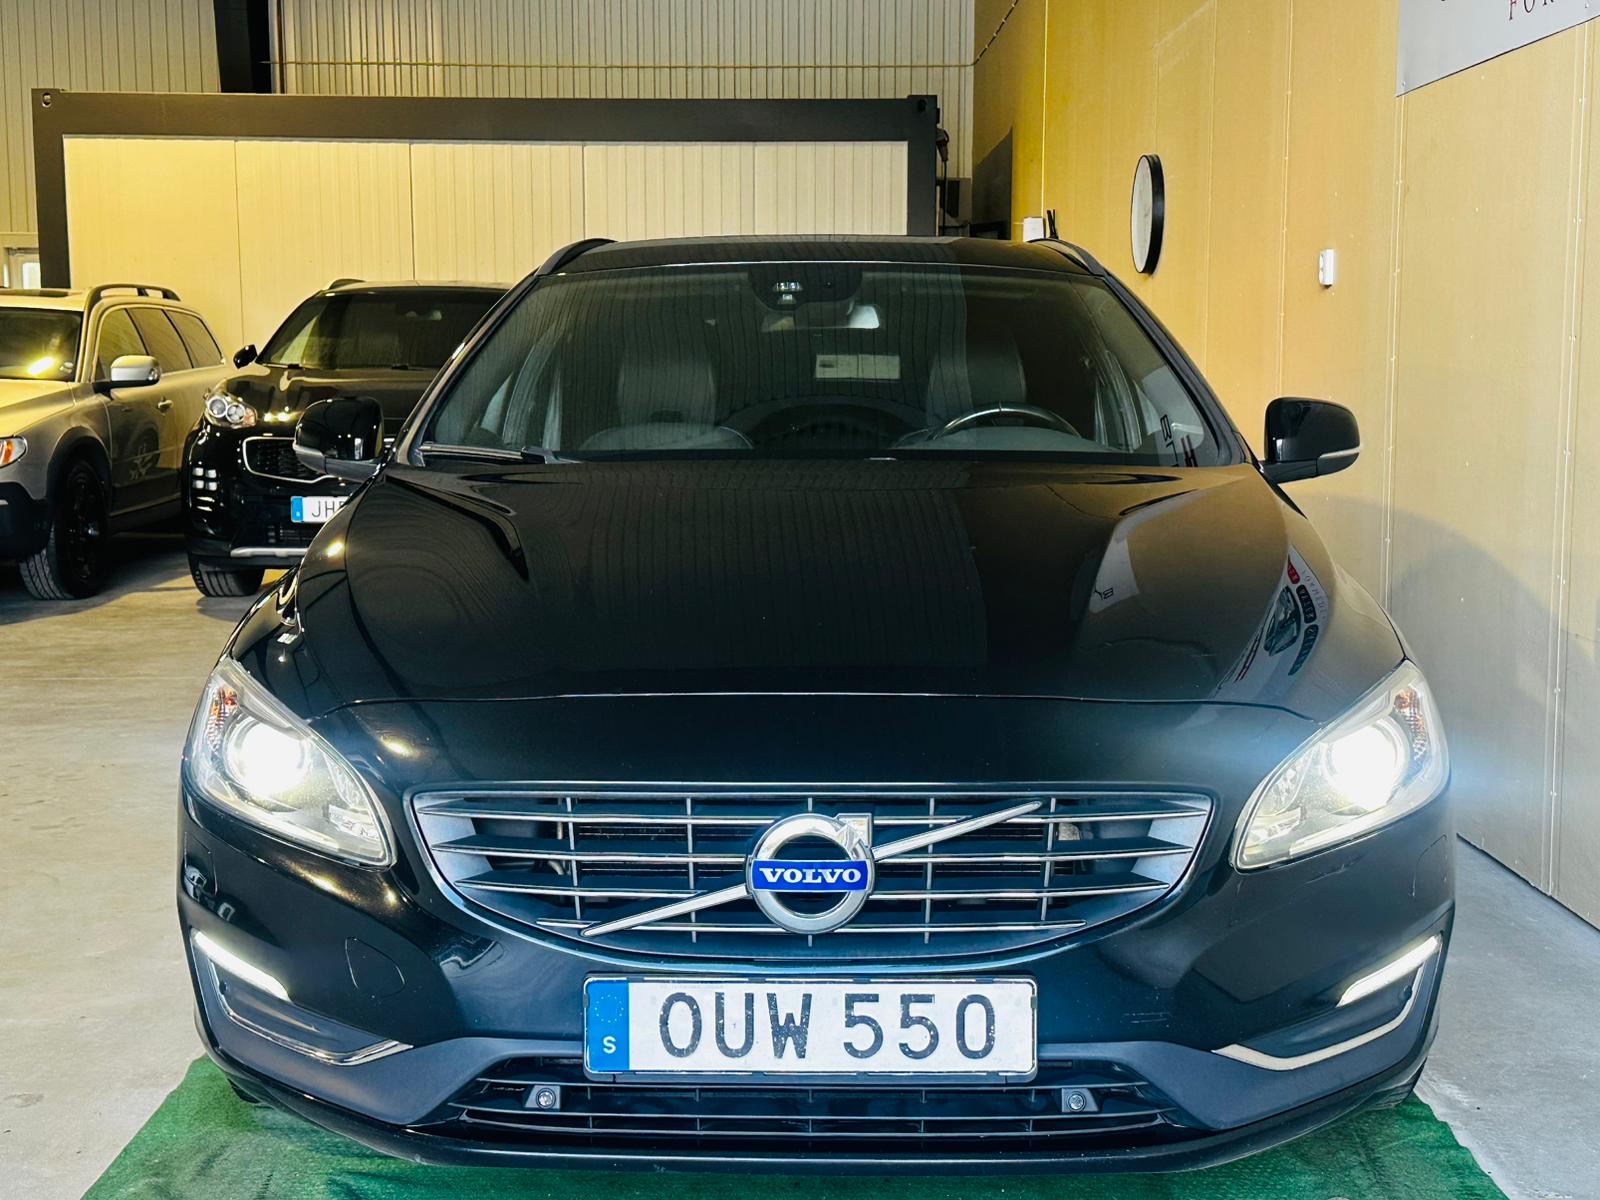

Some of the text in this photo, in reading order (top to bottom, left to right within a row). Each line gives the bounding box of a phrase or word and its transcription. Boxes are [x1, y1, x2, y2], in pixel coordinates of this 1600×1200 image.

[759, 868, 862, 883] VOLVO
[658, 992, 996, 1060] OUW 550
[602, 1036, 617, 1054] S
